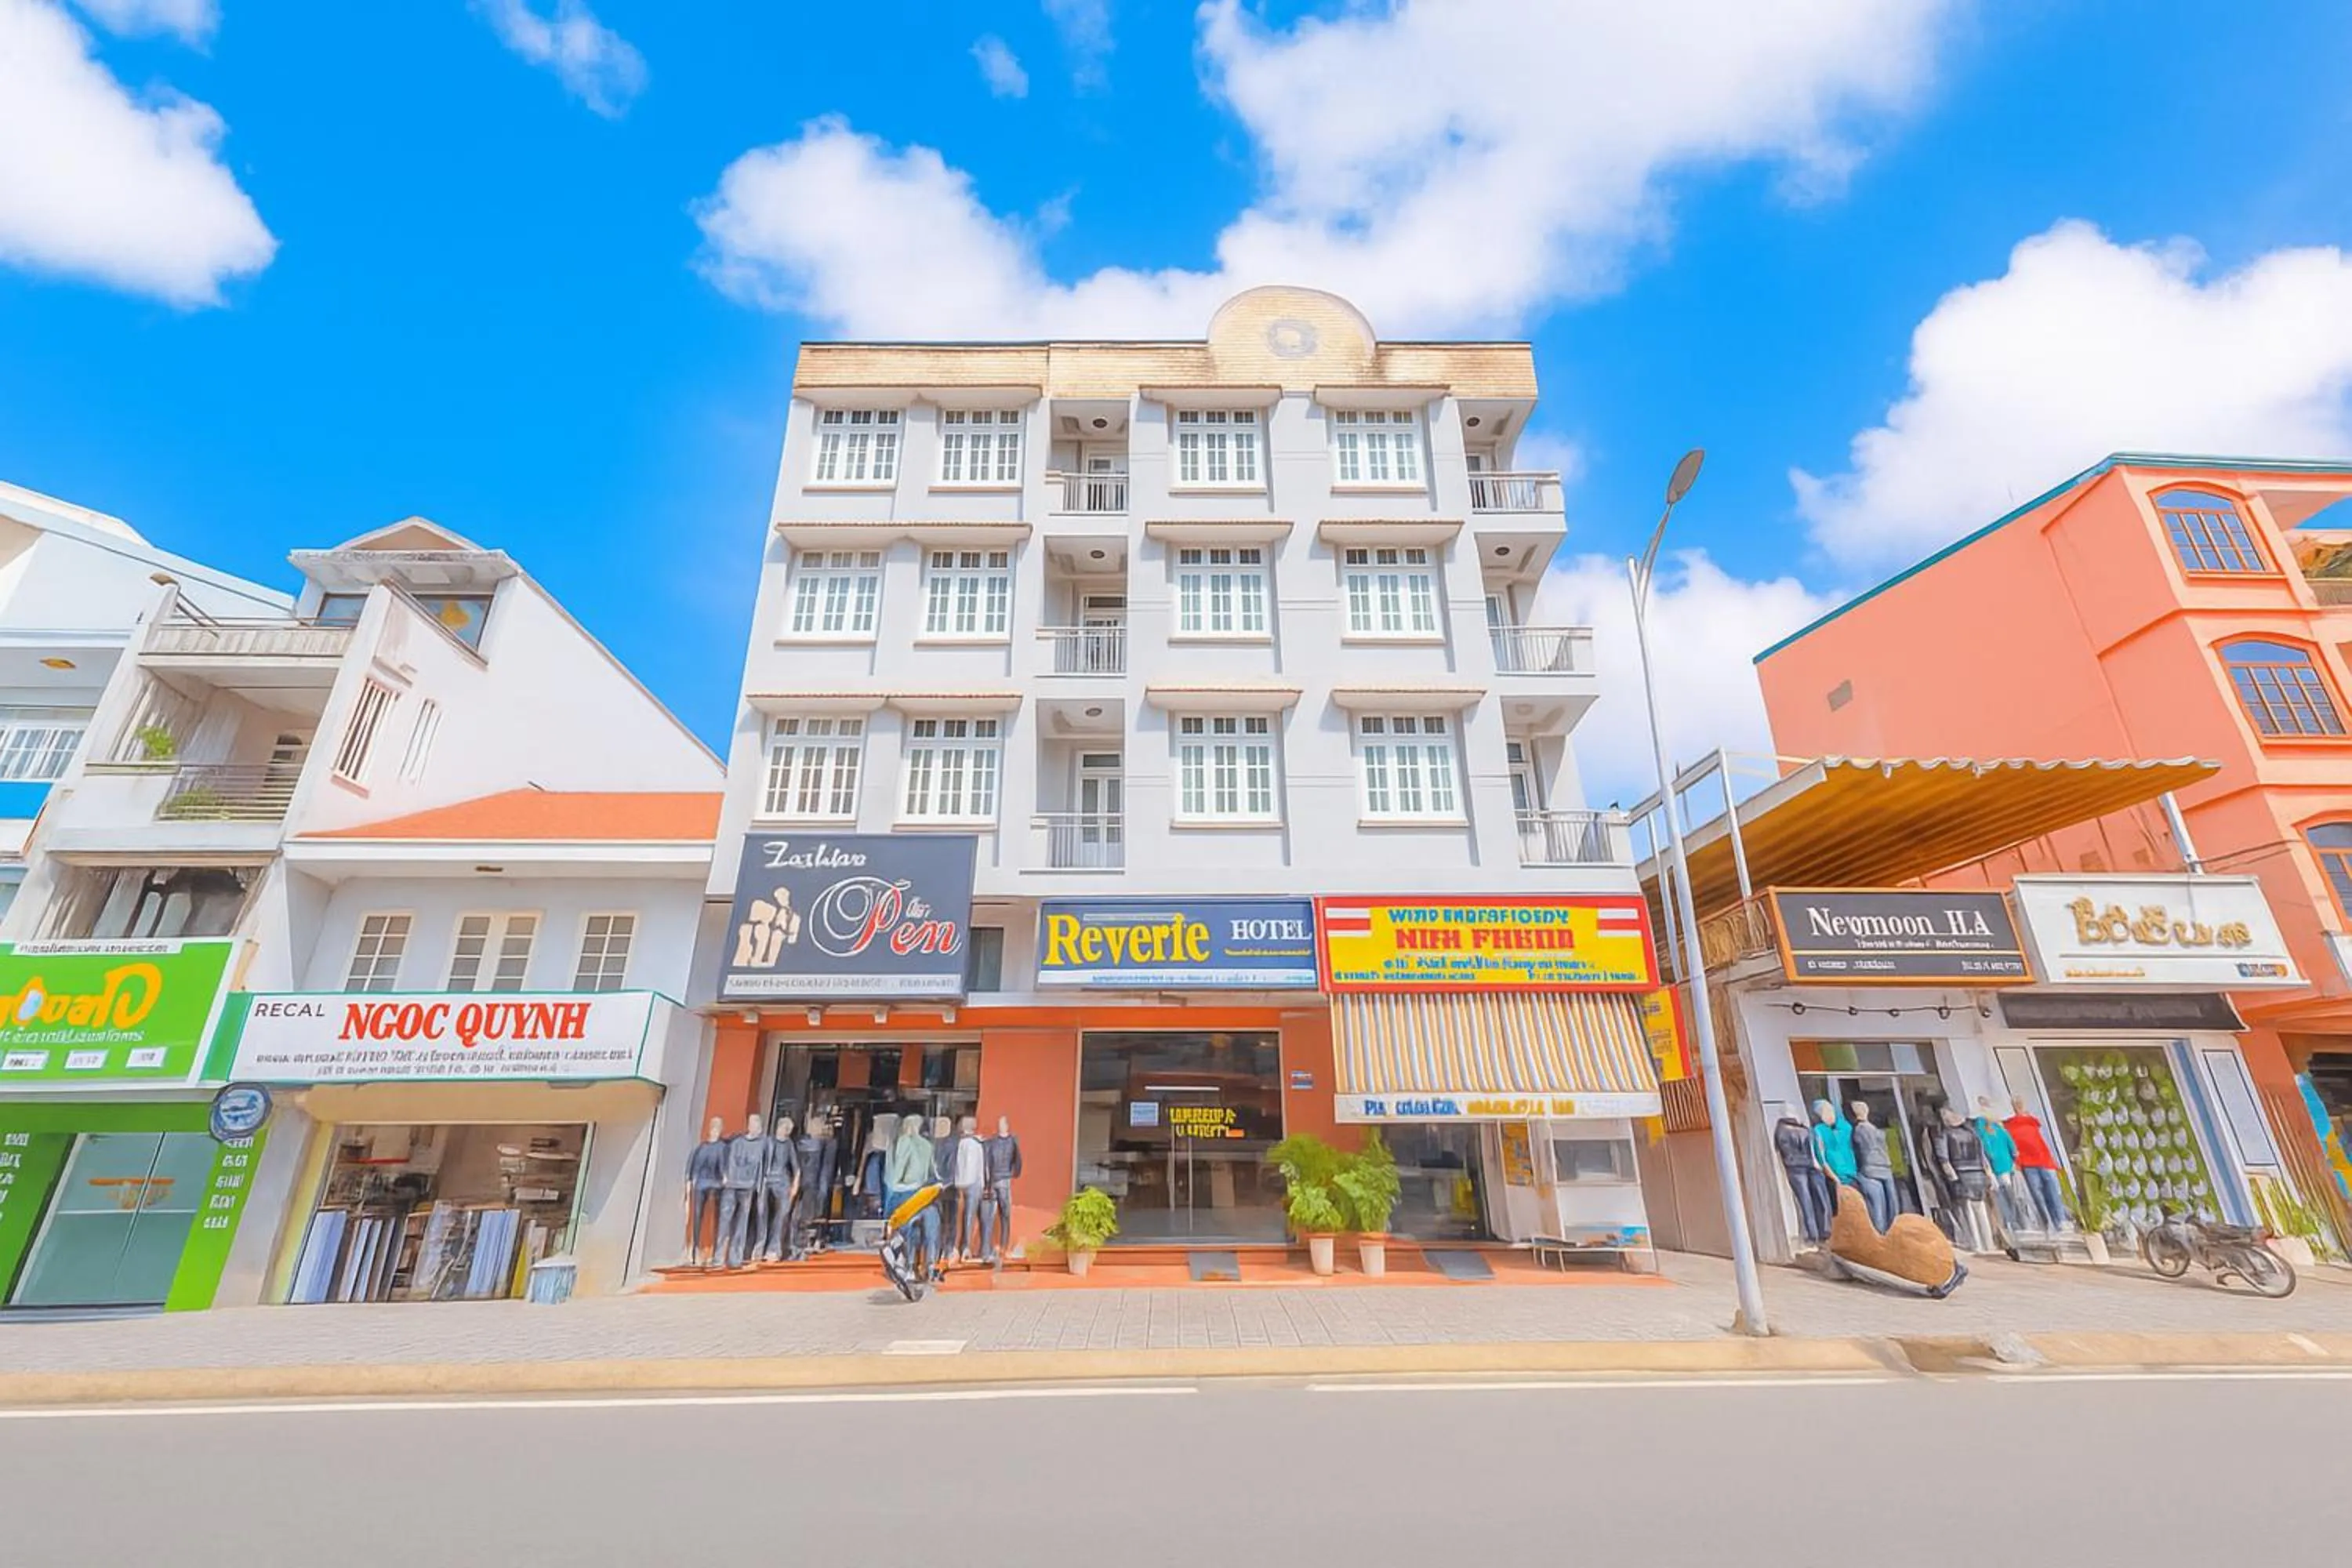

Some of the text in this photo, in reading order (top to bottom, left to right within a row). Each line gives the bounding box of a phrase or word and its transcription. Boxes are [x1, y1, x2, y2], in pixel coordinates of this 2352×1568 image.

[1042, 912, 1312, 966] Reverie HOTEL
[254, 1002, 592, 1048] RECAL NGOC QUYNH
